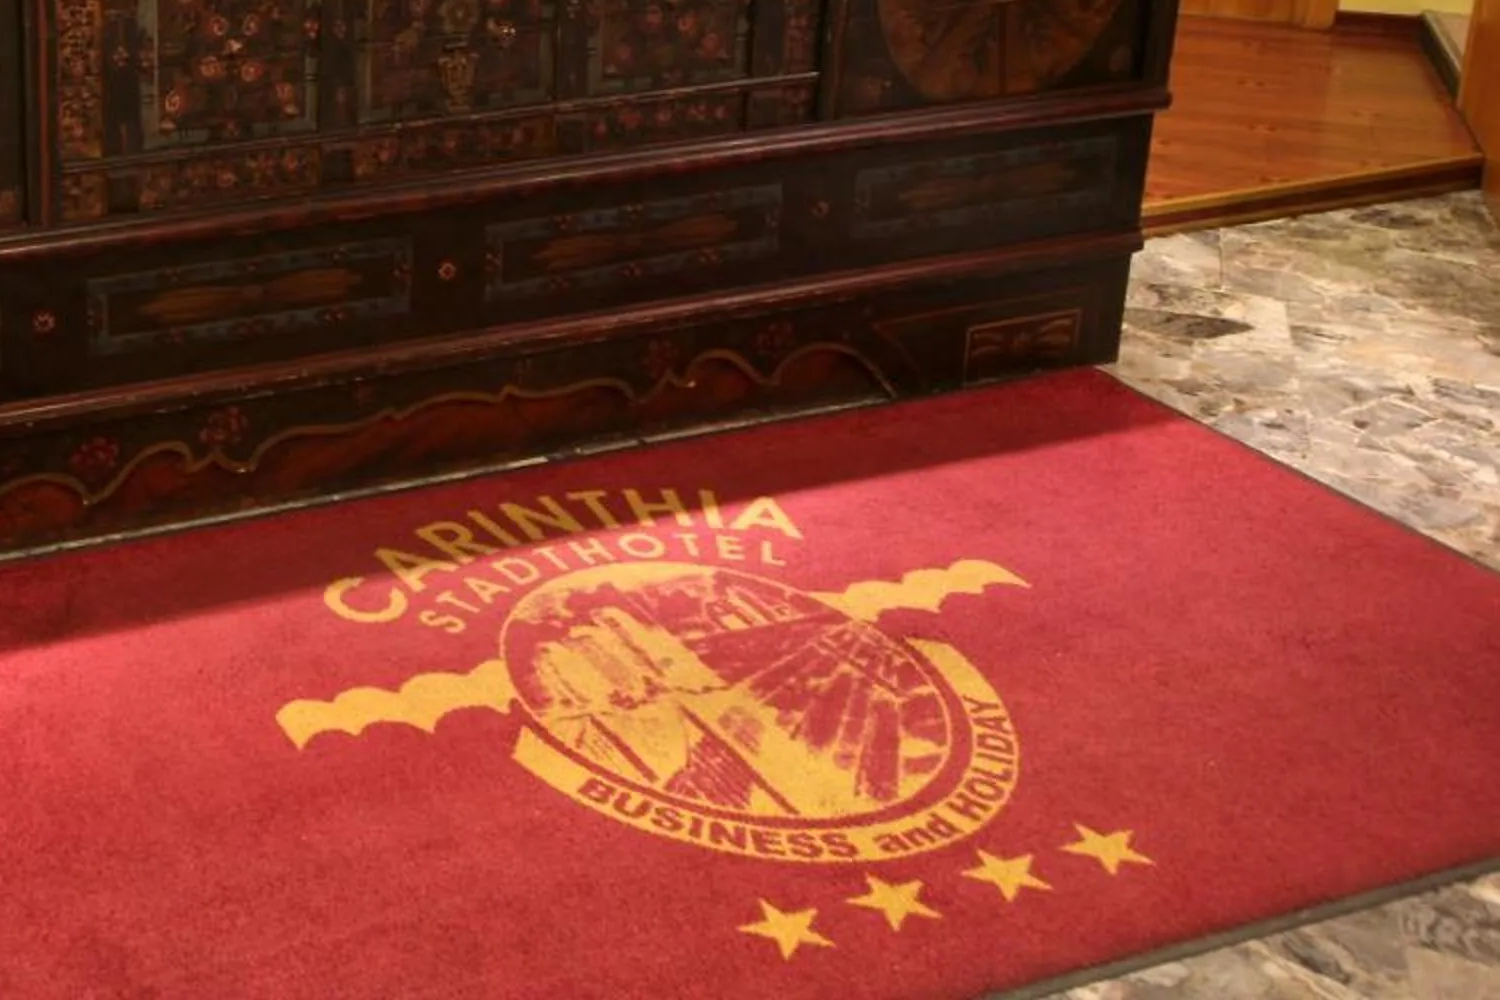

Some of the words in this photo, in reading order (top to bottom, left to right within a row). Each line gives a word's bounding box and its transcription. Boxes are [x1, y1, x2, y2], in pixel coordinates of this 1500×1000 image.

[323, 488, 803, 623] CARINTHIA
[420, 533, 786, 634] STADTHOTEL
[577, 778, 859, 858] BUSINESS
[874, 813, 965, 854] and
[946, 695, 1017, 822] HOLIDAY
